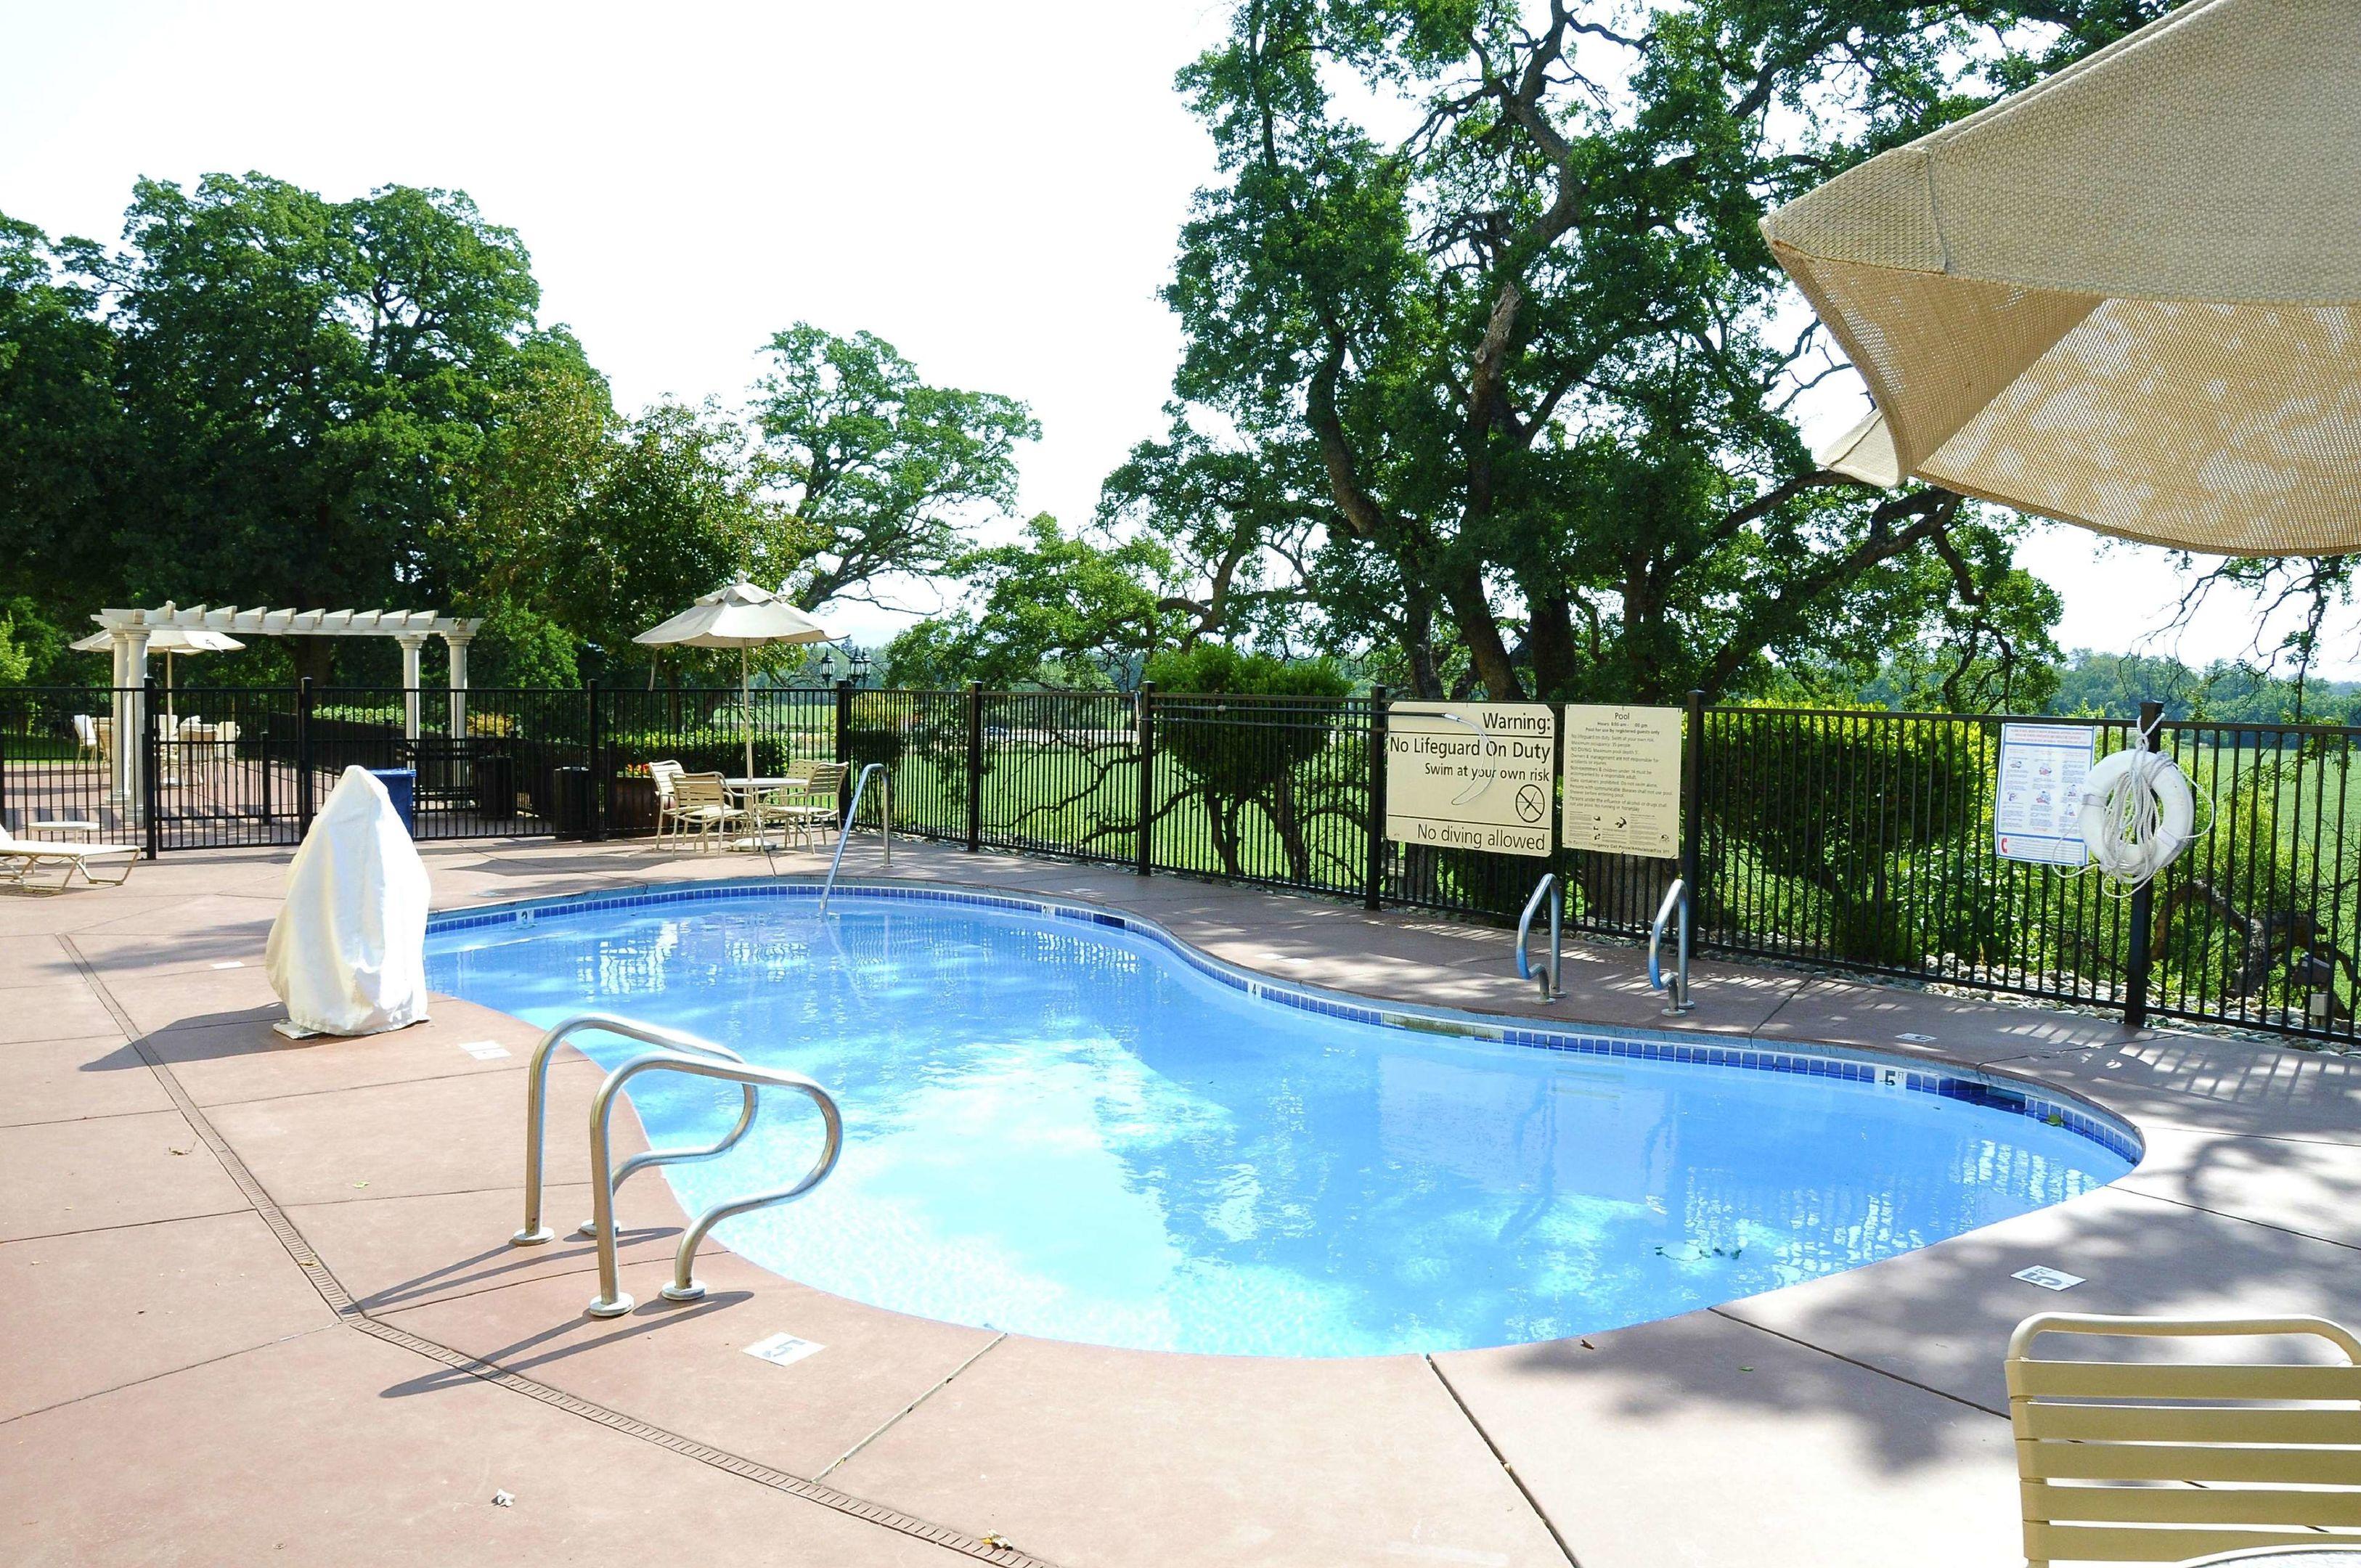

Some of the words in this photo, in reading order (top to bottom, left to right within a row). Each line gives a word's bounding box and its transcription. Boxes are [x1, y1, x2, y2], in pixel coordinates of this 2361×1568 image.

[1483, 712, 1551, 734] Warning:
[1390, 737, 1408, 753] No
[1414, 737, 1480, 758] Lifeguard
[1485, 740, 1506, 757] On
[1513, 742, 1551, 764] Duty
[1424, 762, 1453, 776] Swim
[1457, 765, 1468, 777] at
[1472, 768, 1496, 780] your
[1500, 769, 1525, 780] own
[1530, 768, 1550, 782] risk
[1418, 823, 1437, 840] No
[1441, 825, 1482, 849] diving
[1488, 829, 1545, 851] allowed
[1252, 984, 1257, 995] 4
[1885, 1070, 1896, 1086] 5
[1898, 1071, 1904, 1080] FT
[2021, 1272, 2063, 1286] 5
